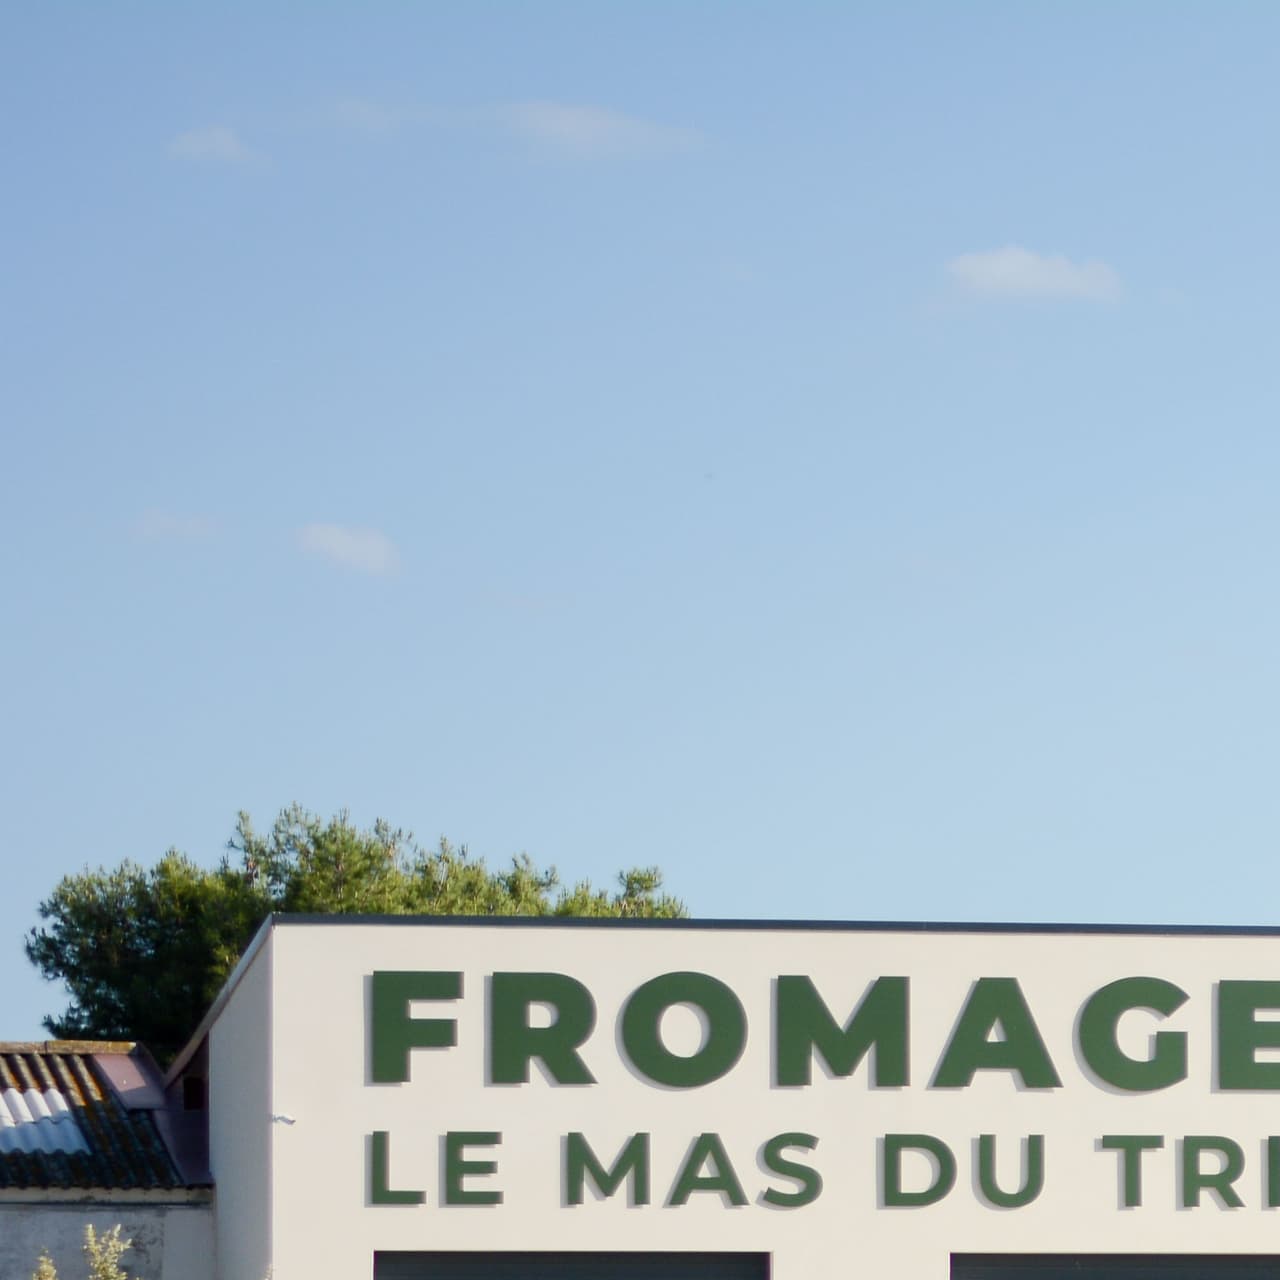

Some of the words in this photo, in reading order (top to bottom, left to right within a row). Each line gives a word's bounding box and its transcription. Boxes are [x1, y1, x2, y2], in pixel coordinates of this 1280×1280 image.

[371, 1131, 503, 1206] LE
[565, 1131, 823, 1208] MAS
[883, 1132, 1045, 1209] DU
